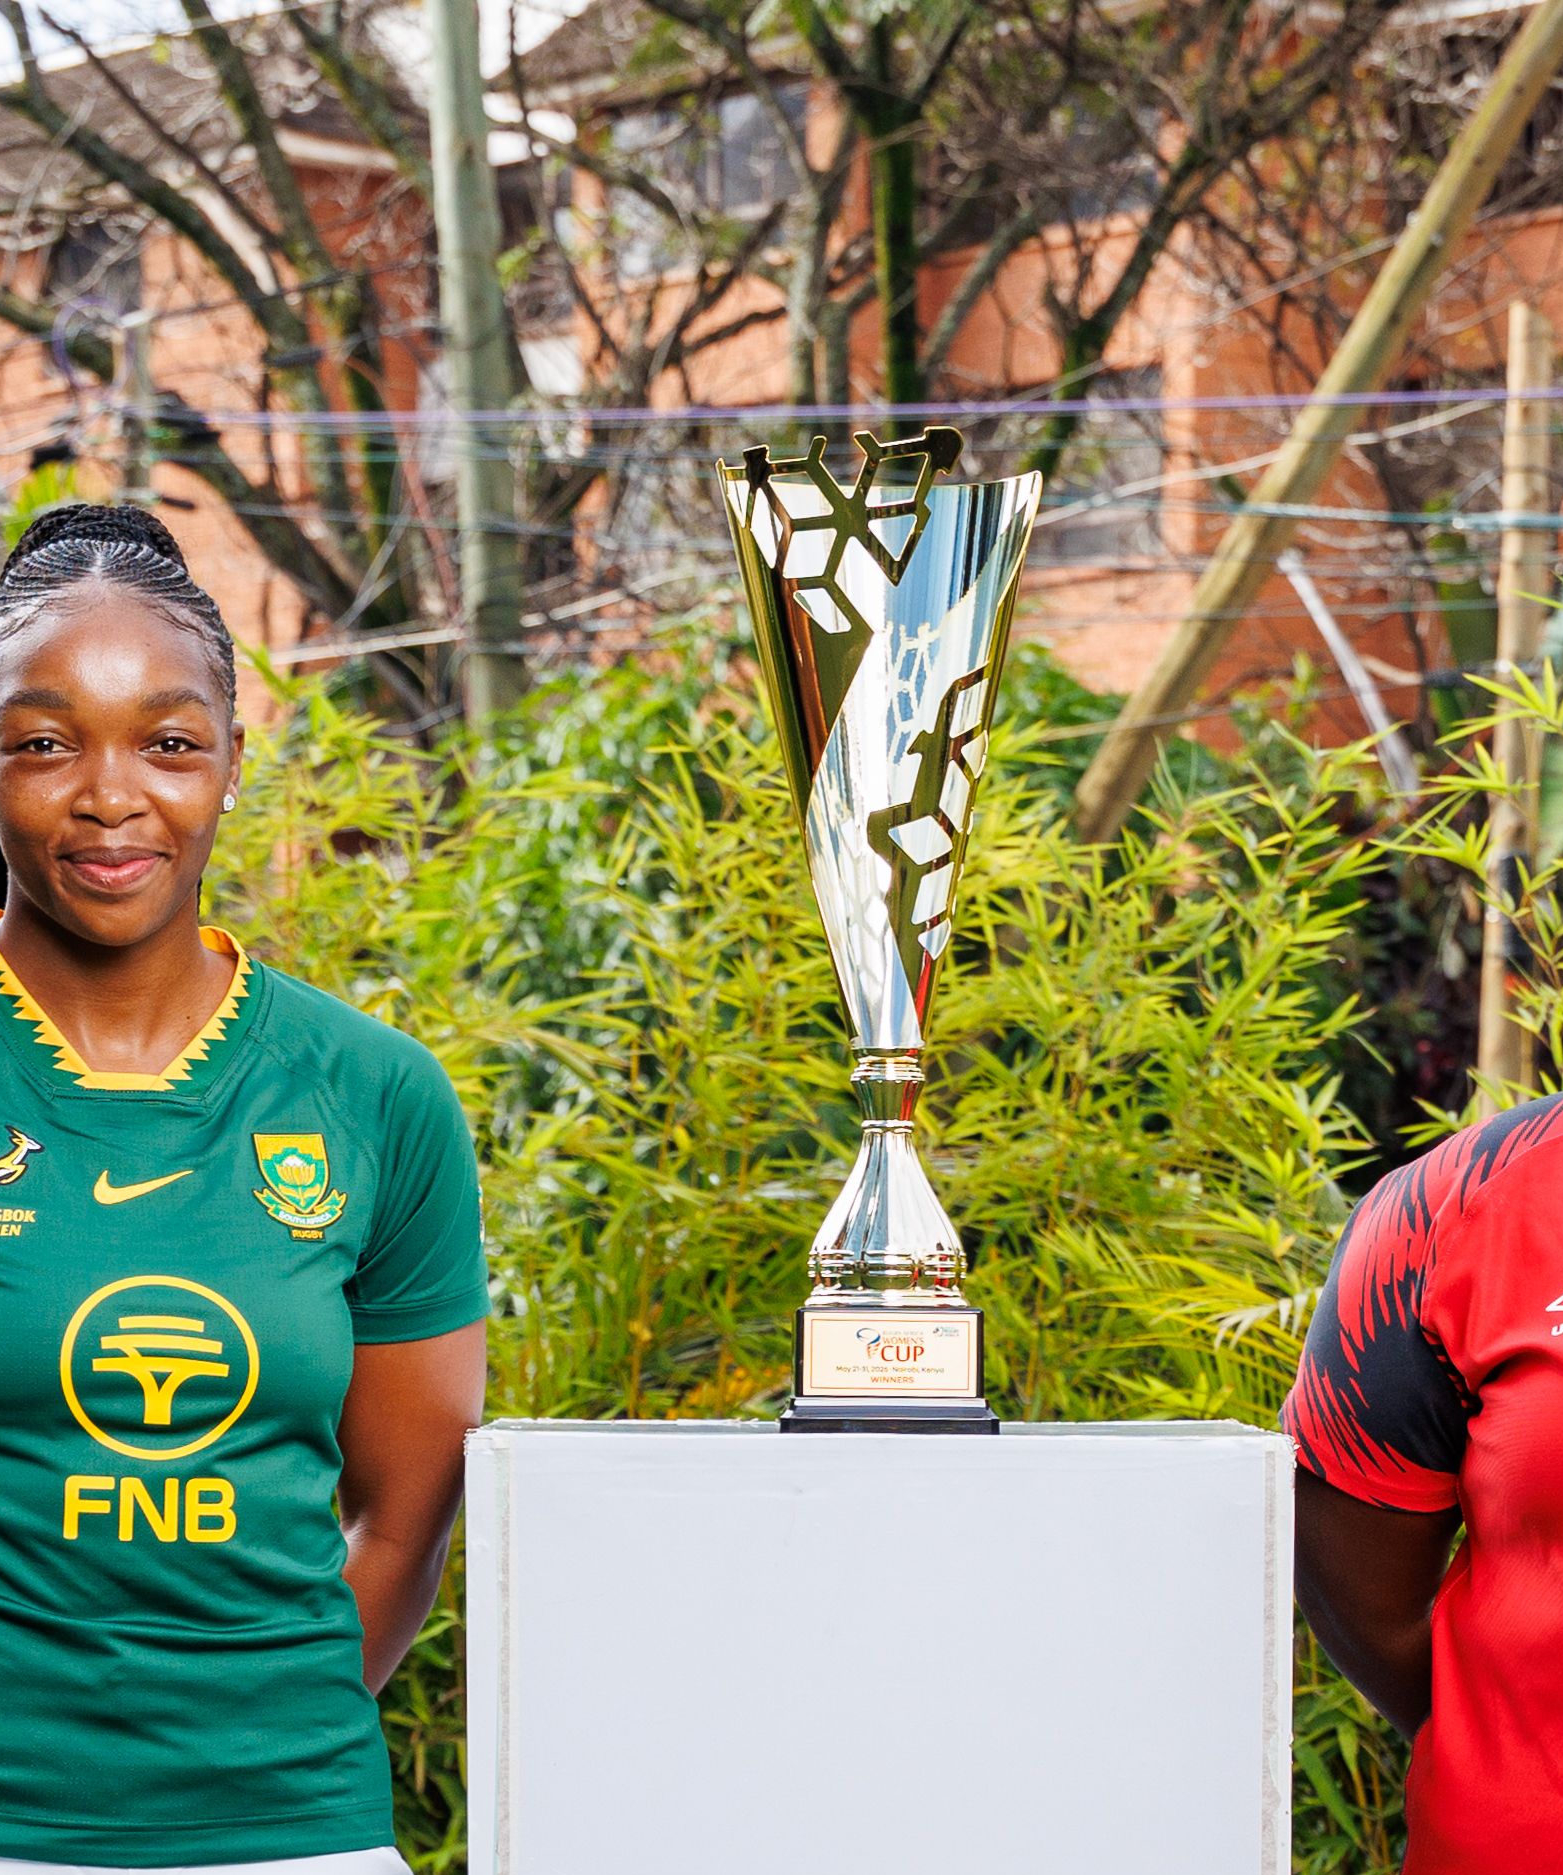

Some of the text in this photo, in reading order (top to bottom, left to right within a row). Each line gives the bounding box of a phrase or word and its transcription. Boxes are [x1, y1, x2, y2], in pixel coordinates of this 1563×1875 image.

[291, 1229, 324, 1239] RUGBY
[882, 1336, 924, 1345] WOMEN'S
[880, 1345, 924, 1362] CUP
[870, 1376, 915, 1384] WINNERS
[62, 1475, 237, 1543] FNB
